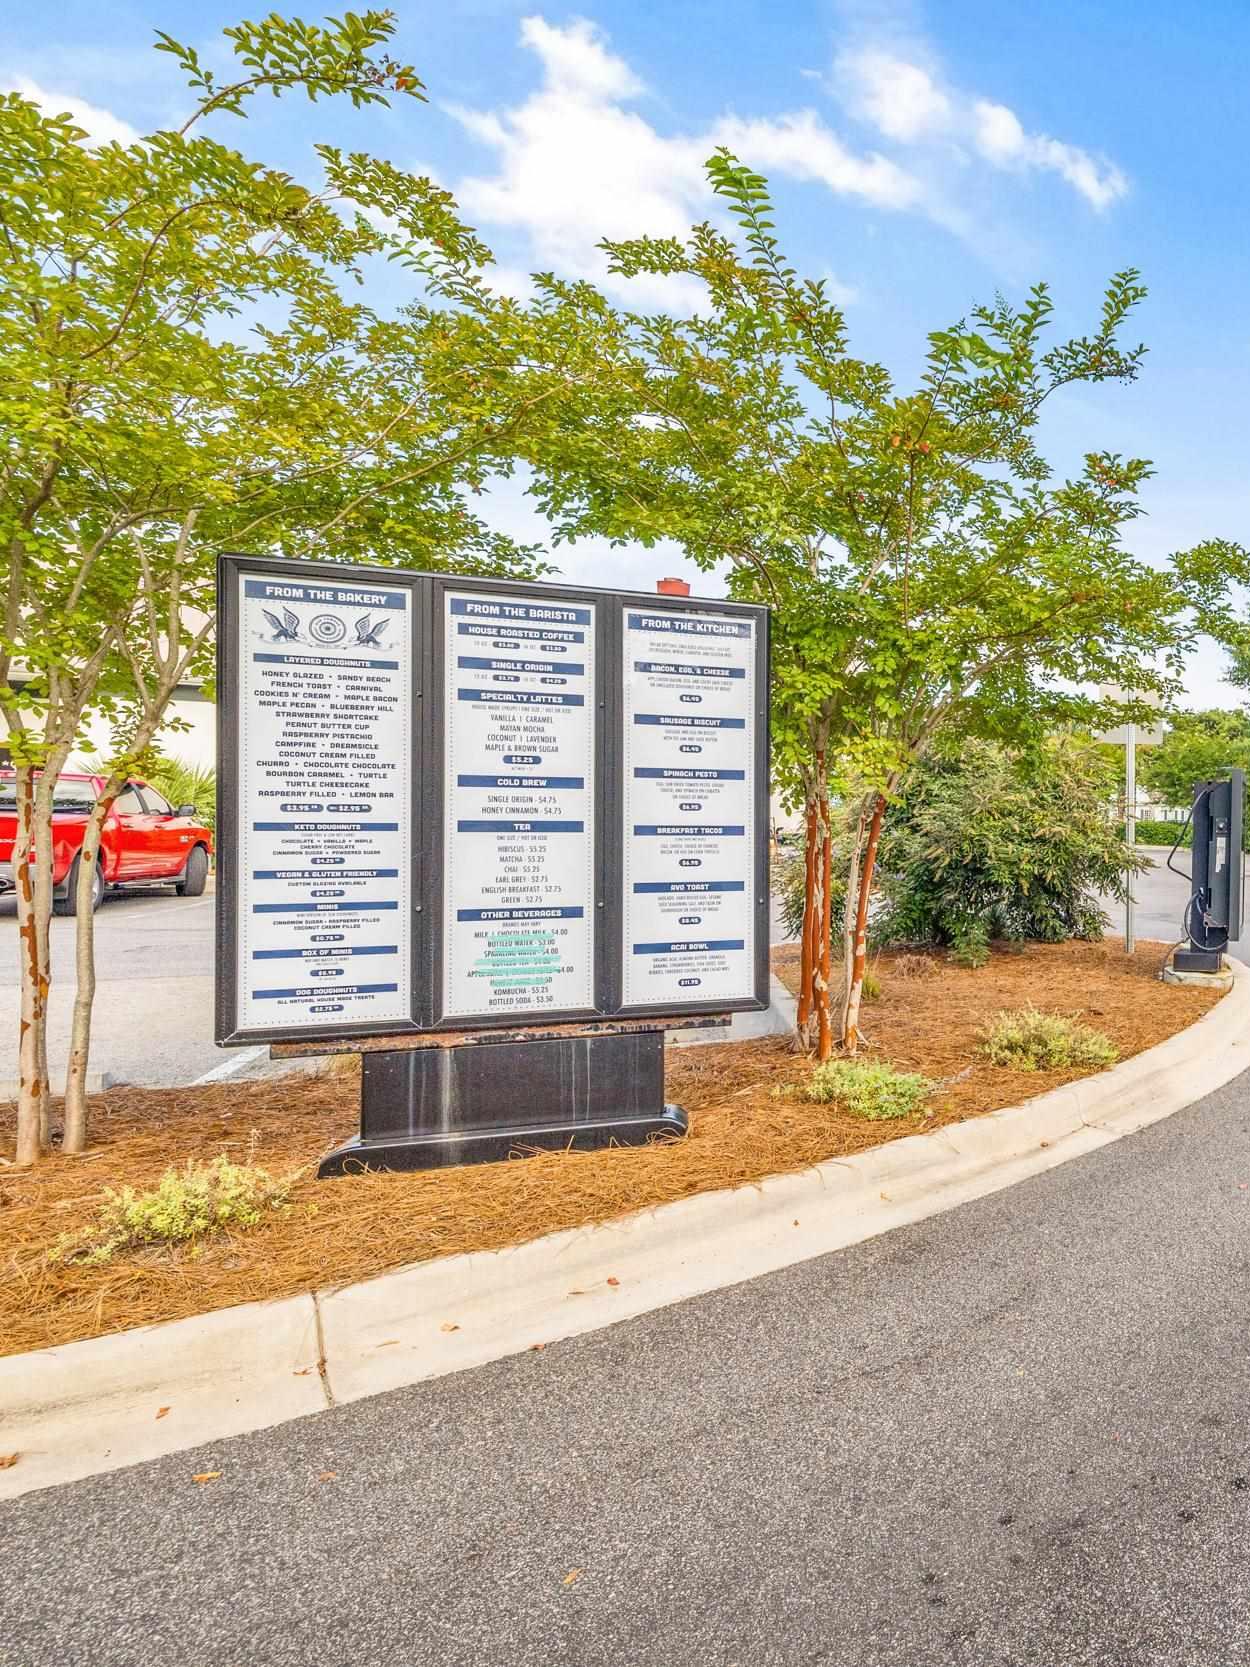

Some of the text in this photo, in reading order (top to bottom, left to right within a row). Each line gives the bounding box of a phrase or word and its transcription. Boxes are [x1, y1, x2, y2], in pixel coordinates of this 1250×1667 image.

[266, 586, 387, 604] FROM THE BAKERY
[466, 604, 576, 620] FROM THE BARISTA
[642, 619, 738, 634] FROM THE KITCHEN
[469, 627, 575, 640] HOUSE ROASTED COFFEE
[284, 656, 371, 667] LAYERED DOUGHNUTS
[491, 662, 553, 671] SINGLE ORIGIN
[346, 684, 383, 692] CARNIVAL
[480, 693, 563, 703] SPECIALTY LATTES
[491, 714, 516, 722] VANILLA
[660, 717, 721, 726] SAUSAGE BISCUIT
[313, 987, 357, 995] DOUGHNUTS
